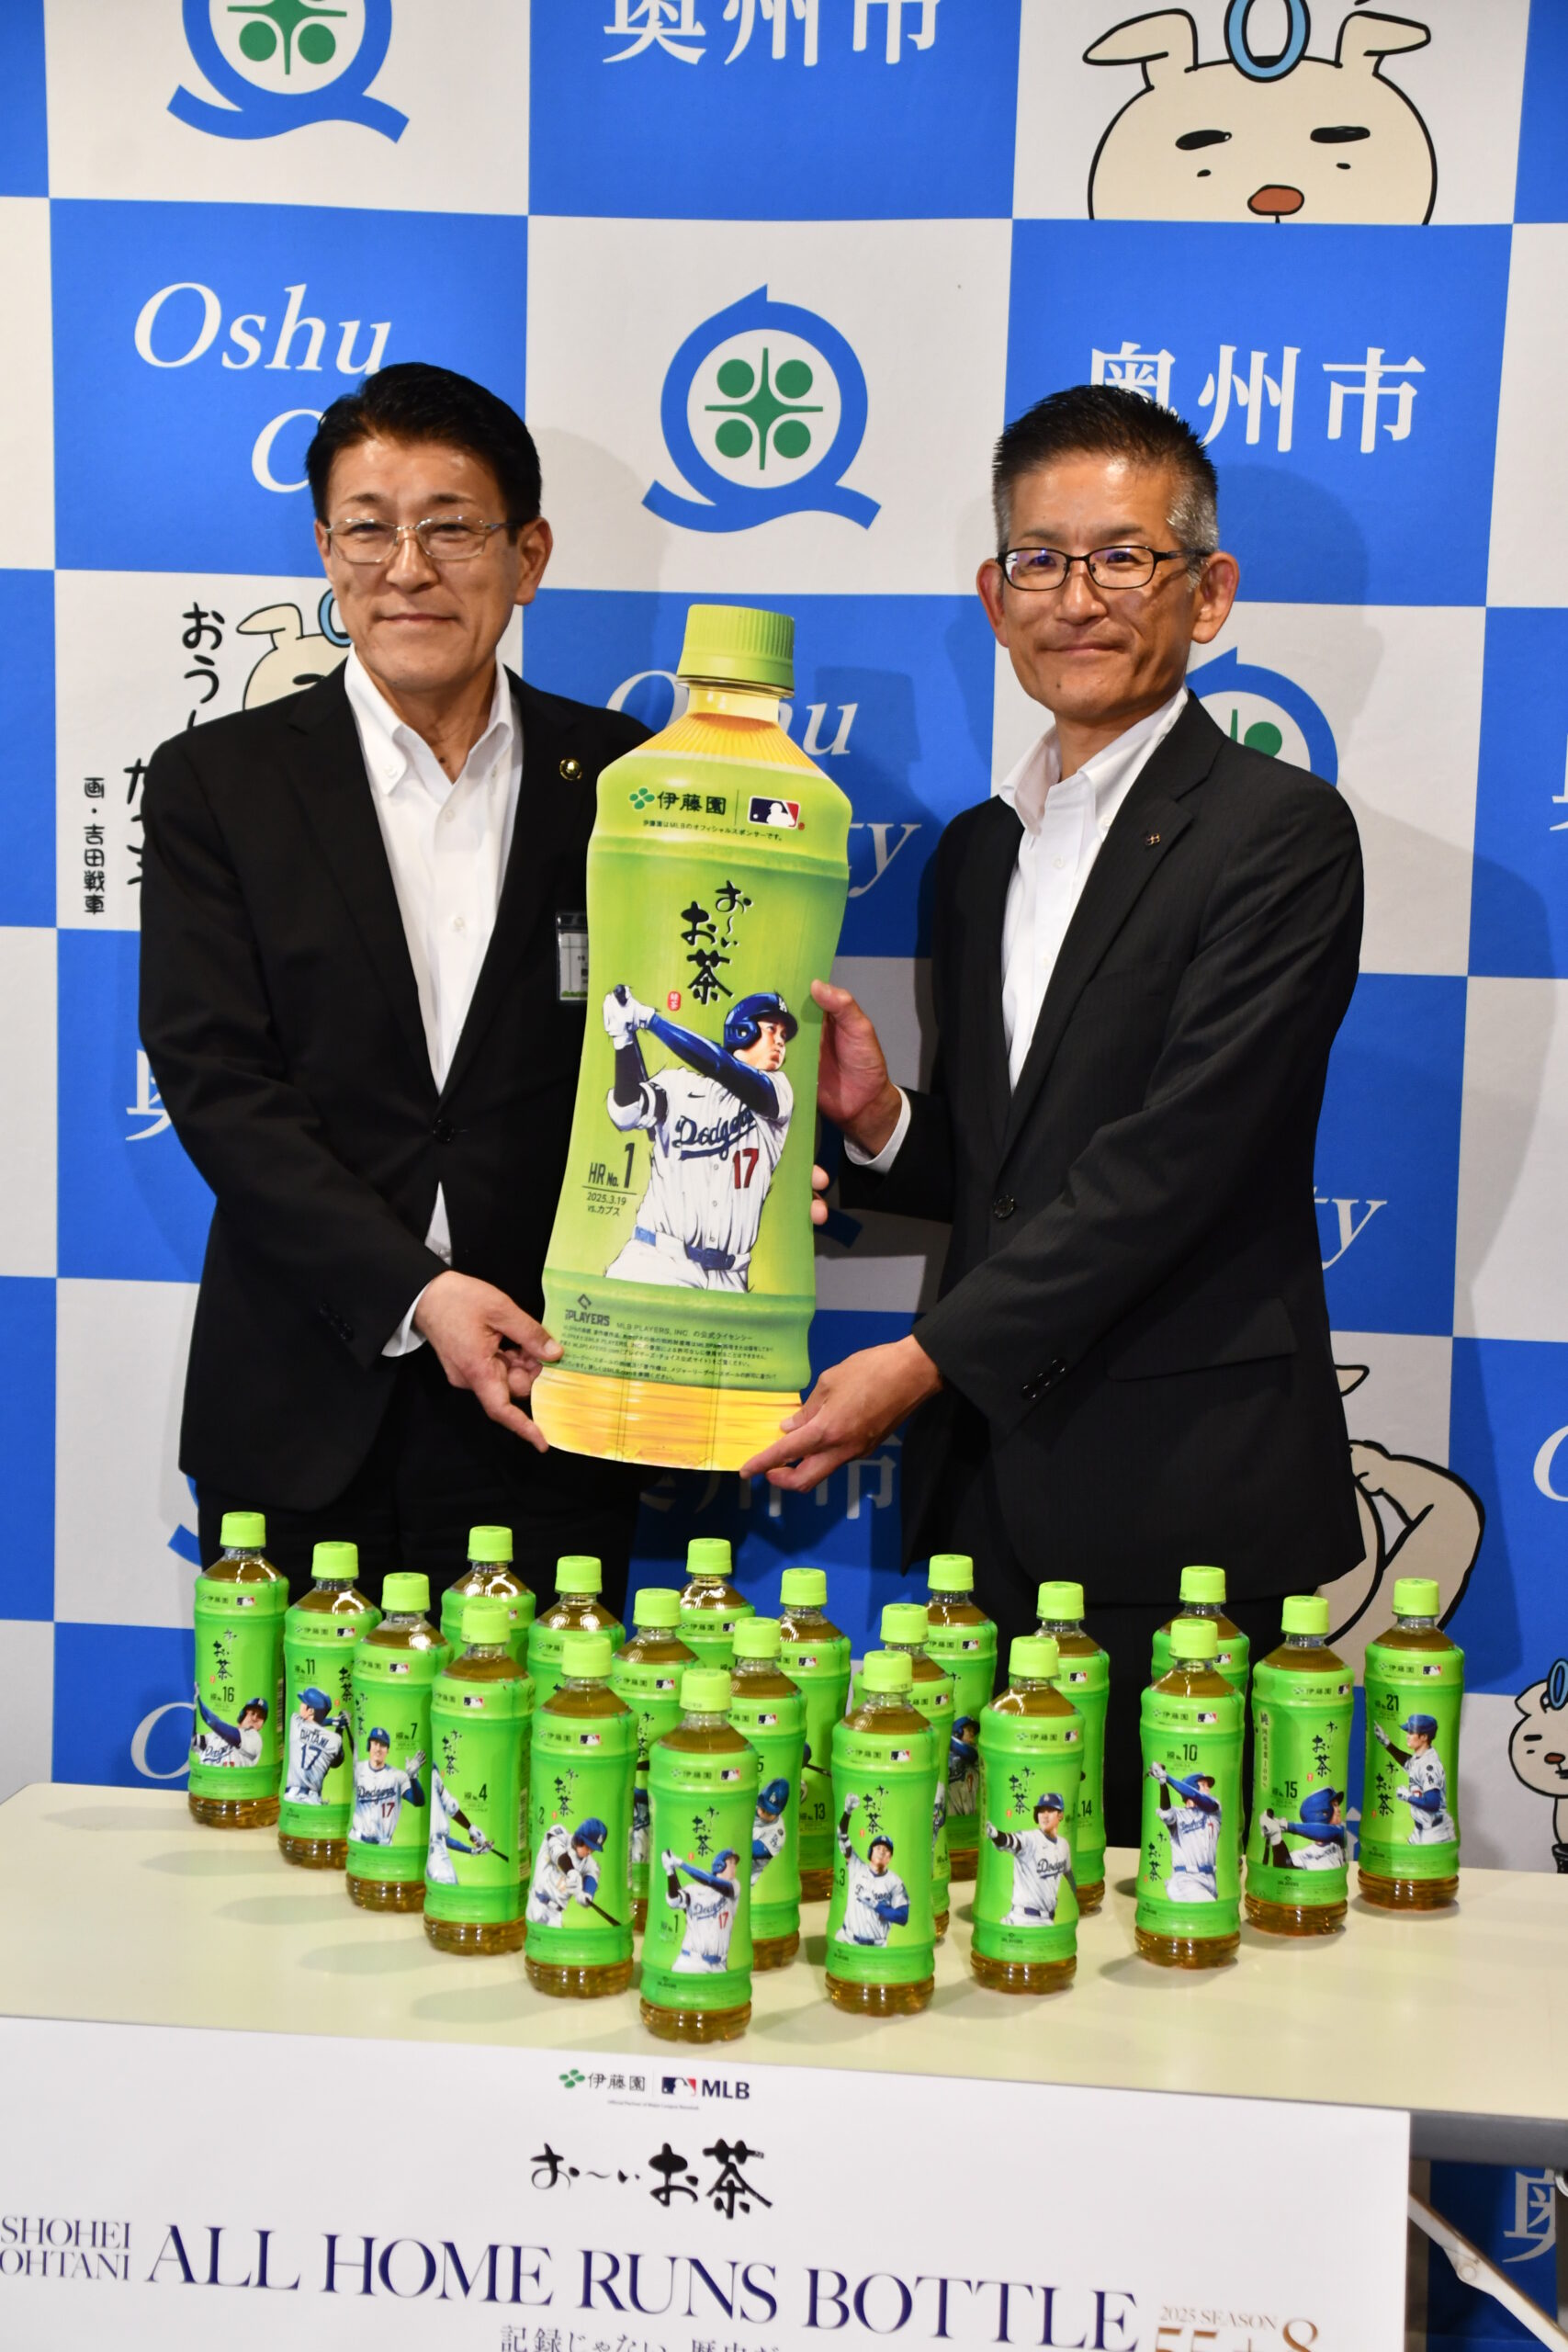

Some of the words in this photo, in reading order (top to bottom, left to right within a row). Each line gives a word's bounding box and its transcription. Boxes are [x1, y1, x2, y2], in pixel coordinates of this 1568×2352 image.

[133, 282, 392, 375] Oshu
[182, 601, 225, 729] おう
[658, 790, 727, 816] 伊藤園
[681, 900, 733, 1005] お茶
[588, 1162, 606, 1185] HR
[624, 1142, 636, 1189] 1
[732, 1148, 760, 1190] 17
[586, 1192, 627, 1206] 2025.3.19
[306, 1658, 315, 1676] 11
[223, 1686, 234, 1702] 16
[1386, 1693, 1400, 1713] 21
[411, 1722, 418, 1739] 7
[300, 1745, 321, 1771] 17
[1183, 1744, 1198, 1762] 10
[479, 1783, 487, 1802] 4
[1284, 1781, 1298, 1799] 15
[381, 1802, 395, 1818] 17
[814, 1803, 826, 1821] 13
[1082, 1800, 1092, 1817] 14
[840, 1868, 846, 1887] 3
[718, 1911, 729, 1929] 17
[588, 2072, 645, 2092] 伊藤園
[702, 2079, 750, 2100] MLB
[1, 2215, 130, 2250] SHOHEI
[0, 2248, 130, 2281] OHTANI
[144, 2224, 301, 2291] ALL
[320, 2233, 554, 2307] HOME
[575, 2248, 779, 2324] RUNS
[801, 2267, 1139, 2352] BOTTLE
[1160, 2305, 1196, 2323] 2025
[1200, 2310, 1278, 2331] SEASON
